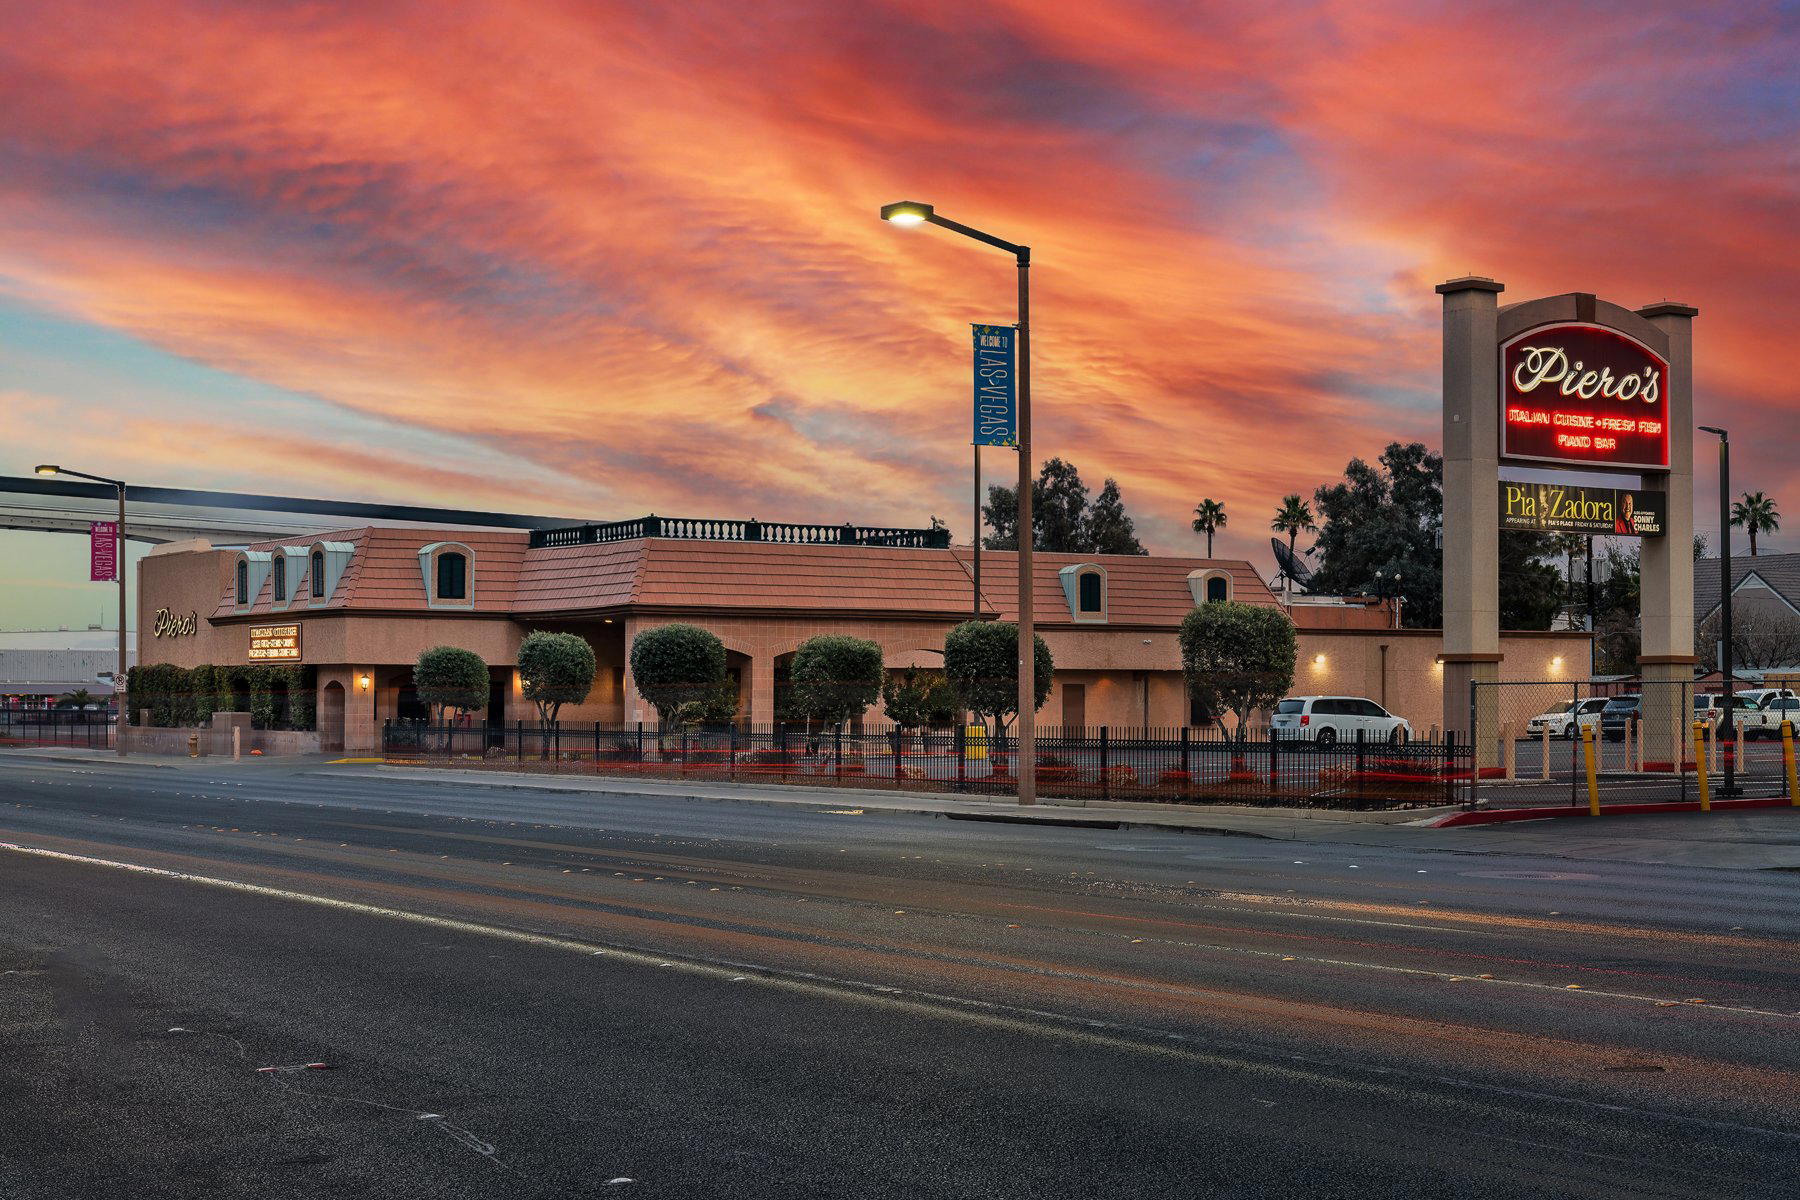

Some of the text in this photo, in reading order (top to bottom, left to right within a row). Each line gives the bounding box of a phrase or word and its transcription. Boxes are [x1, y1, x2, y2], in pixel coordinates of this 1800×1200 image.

[980, 335, 1008, 348] WELCOME TO
[1512, 346, 1660, 404] Piero's
[980, 349, 1009, 436] LAS VEGAS
[1508, 409, 1662, 433] ITALIAN CUISINE FRESH FISH
[1557, 434, 1616, 449] PIANO BAR
[1505, 486, 1614, 522] Pia Zadora
[1505, 517, 1529, 525] APPEARING
[1560, 520, 1574, 528] PLACE
[1593, 522, 1614, 530] SATURDAY
[1633, 515, 1655, 524] SONNY
[1633, 523, 1660, 532] CHARLES
[94, 533, 113, 576] LAS VEGAS
[154, 608, 197, 637] Piero's
